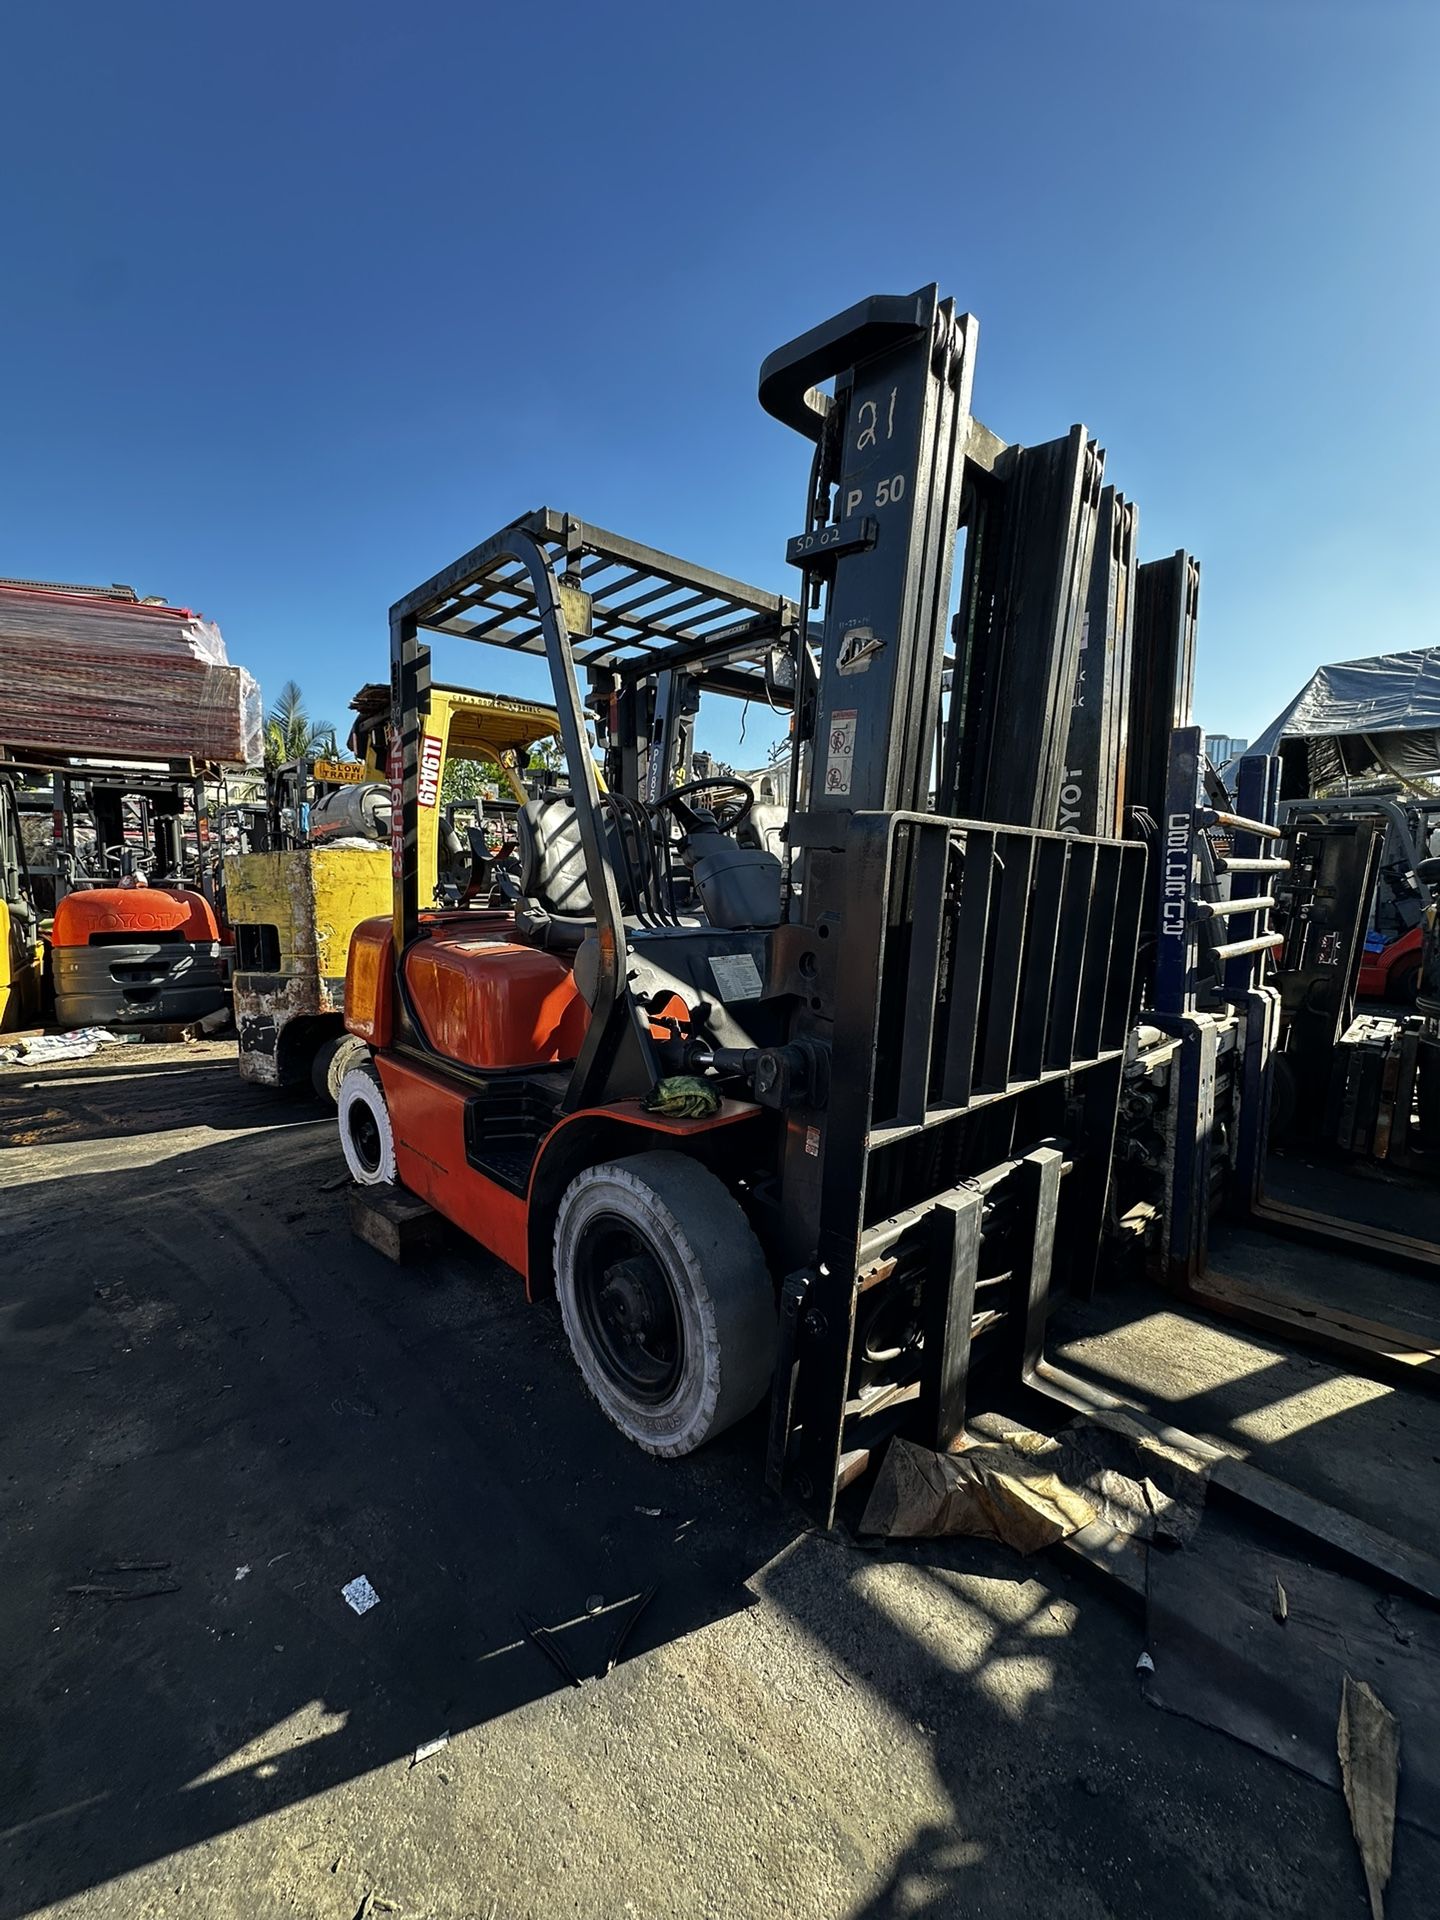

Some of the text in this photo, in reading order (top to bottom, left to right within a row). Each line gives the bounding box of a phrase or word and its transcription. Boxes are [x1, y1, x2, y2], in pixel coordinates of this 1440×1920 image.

[856, 386, 898, 450] 21
[846, 475, 906, 517] P 50
[796, 529, 841, 553] SD 02
[330, 763, 360, 773] SLOW
[417, 738, 442, 806] LL9A49
[87, 911, 188, 930] TOYOTA
